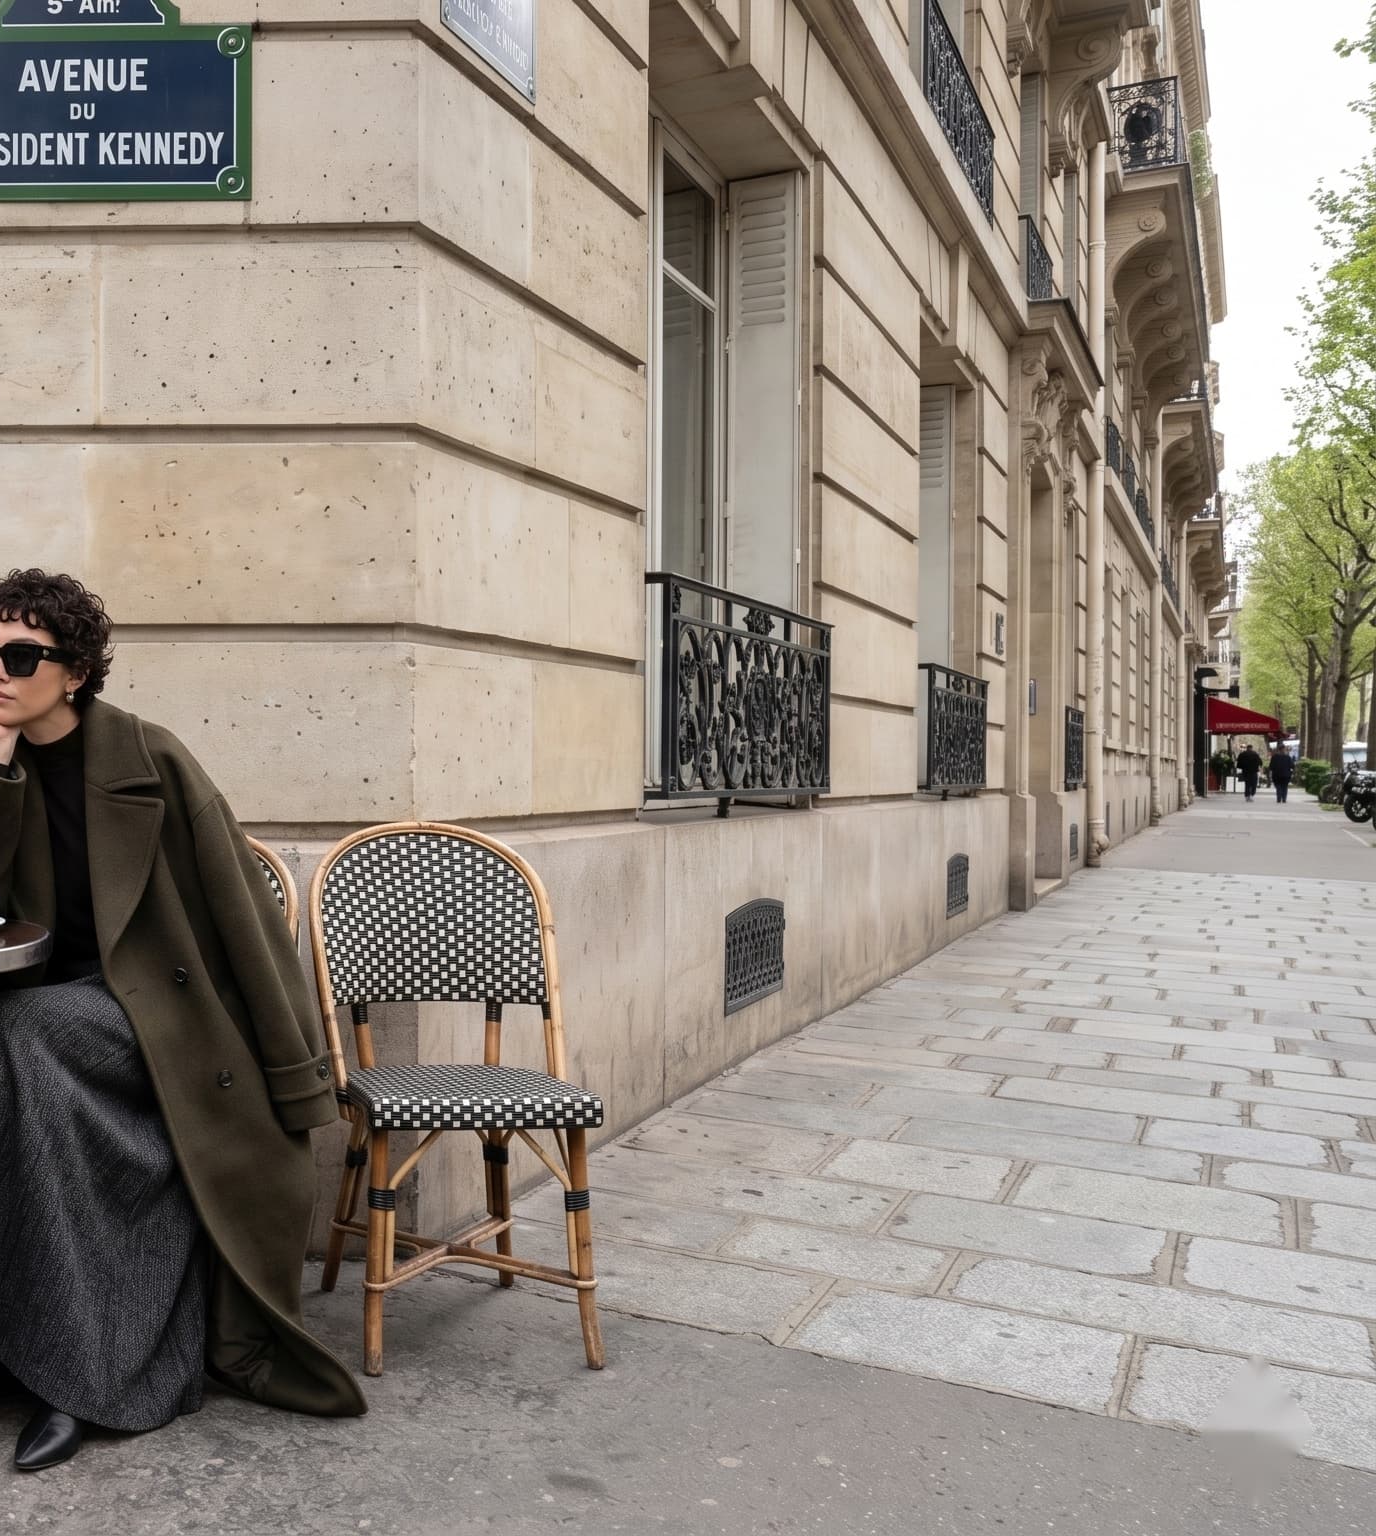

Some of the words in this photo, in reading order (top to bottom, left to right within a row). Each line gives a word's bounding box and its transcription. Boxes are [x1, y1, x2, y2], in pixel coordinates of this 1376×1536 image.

[18, 58, 149, 92] AVENUE
[70, 102, 96, 120] DU
[98, 131, 225, 166] KENNEDY
